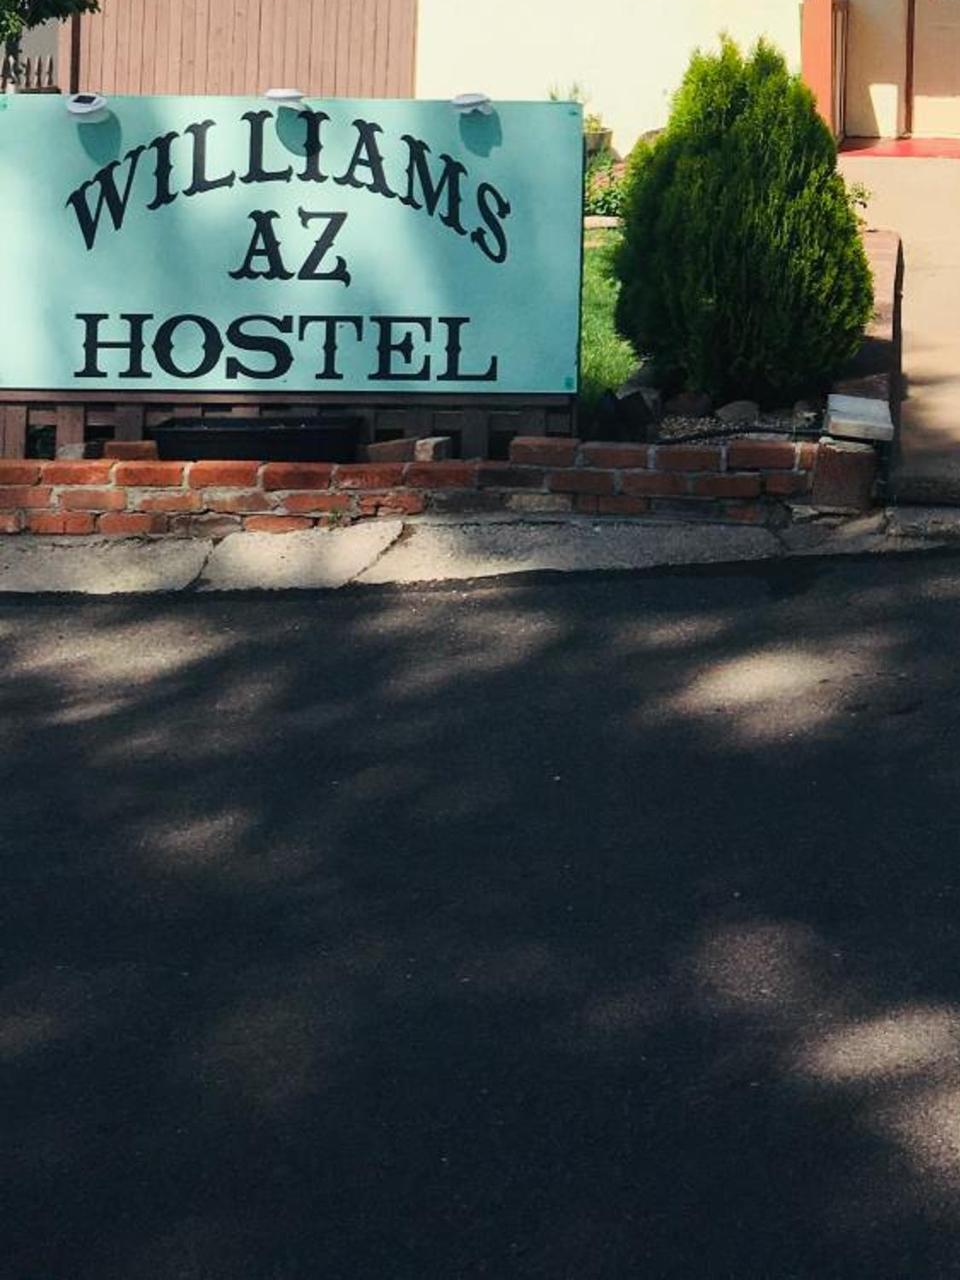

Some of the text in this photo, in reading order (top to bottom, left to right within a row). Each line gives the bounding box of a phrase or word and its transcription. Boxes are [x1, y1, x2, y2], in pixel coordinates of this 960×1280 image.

[66, 110, 511, 264] WILLIAMS
[228, 207, 351, 287] AZ
[74, 313, 498, 382] HOSTEL
